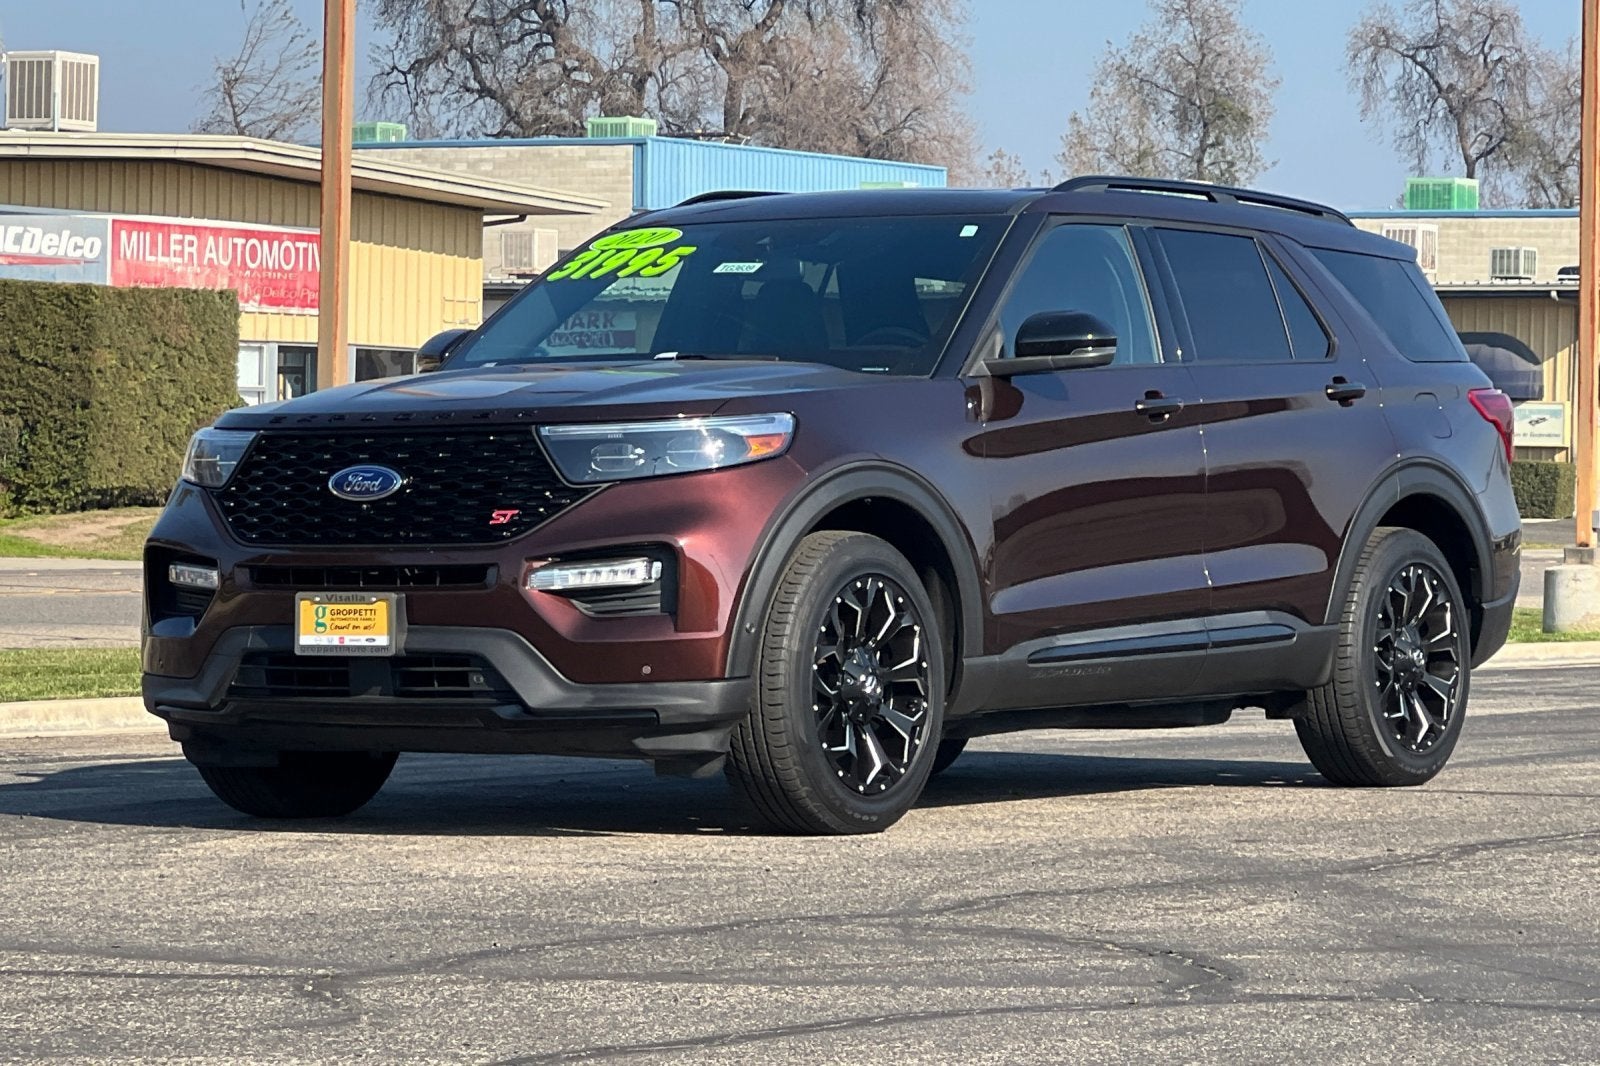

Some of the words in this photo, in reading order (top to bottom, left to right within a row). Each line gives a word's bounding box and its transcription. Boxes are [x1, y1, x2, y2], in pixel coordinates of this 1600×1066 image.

[0, 225, 102, 259] CDelco
[119, 230, 198, 266] MILLER
[547, 247, 697, 281] 31995
[343, 472, 384, 492] Ford
[490, 509, 520, 524] ST
[325, 594, 366, 602] Visalia
[330, 608, 376, 616] GROPPETTI
